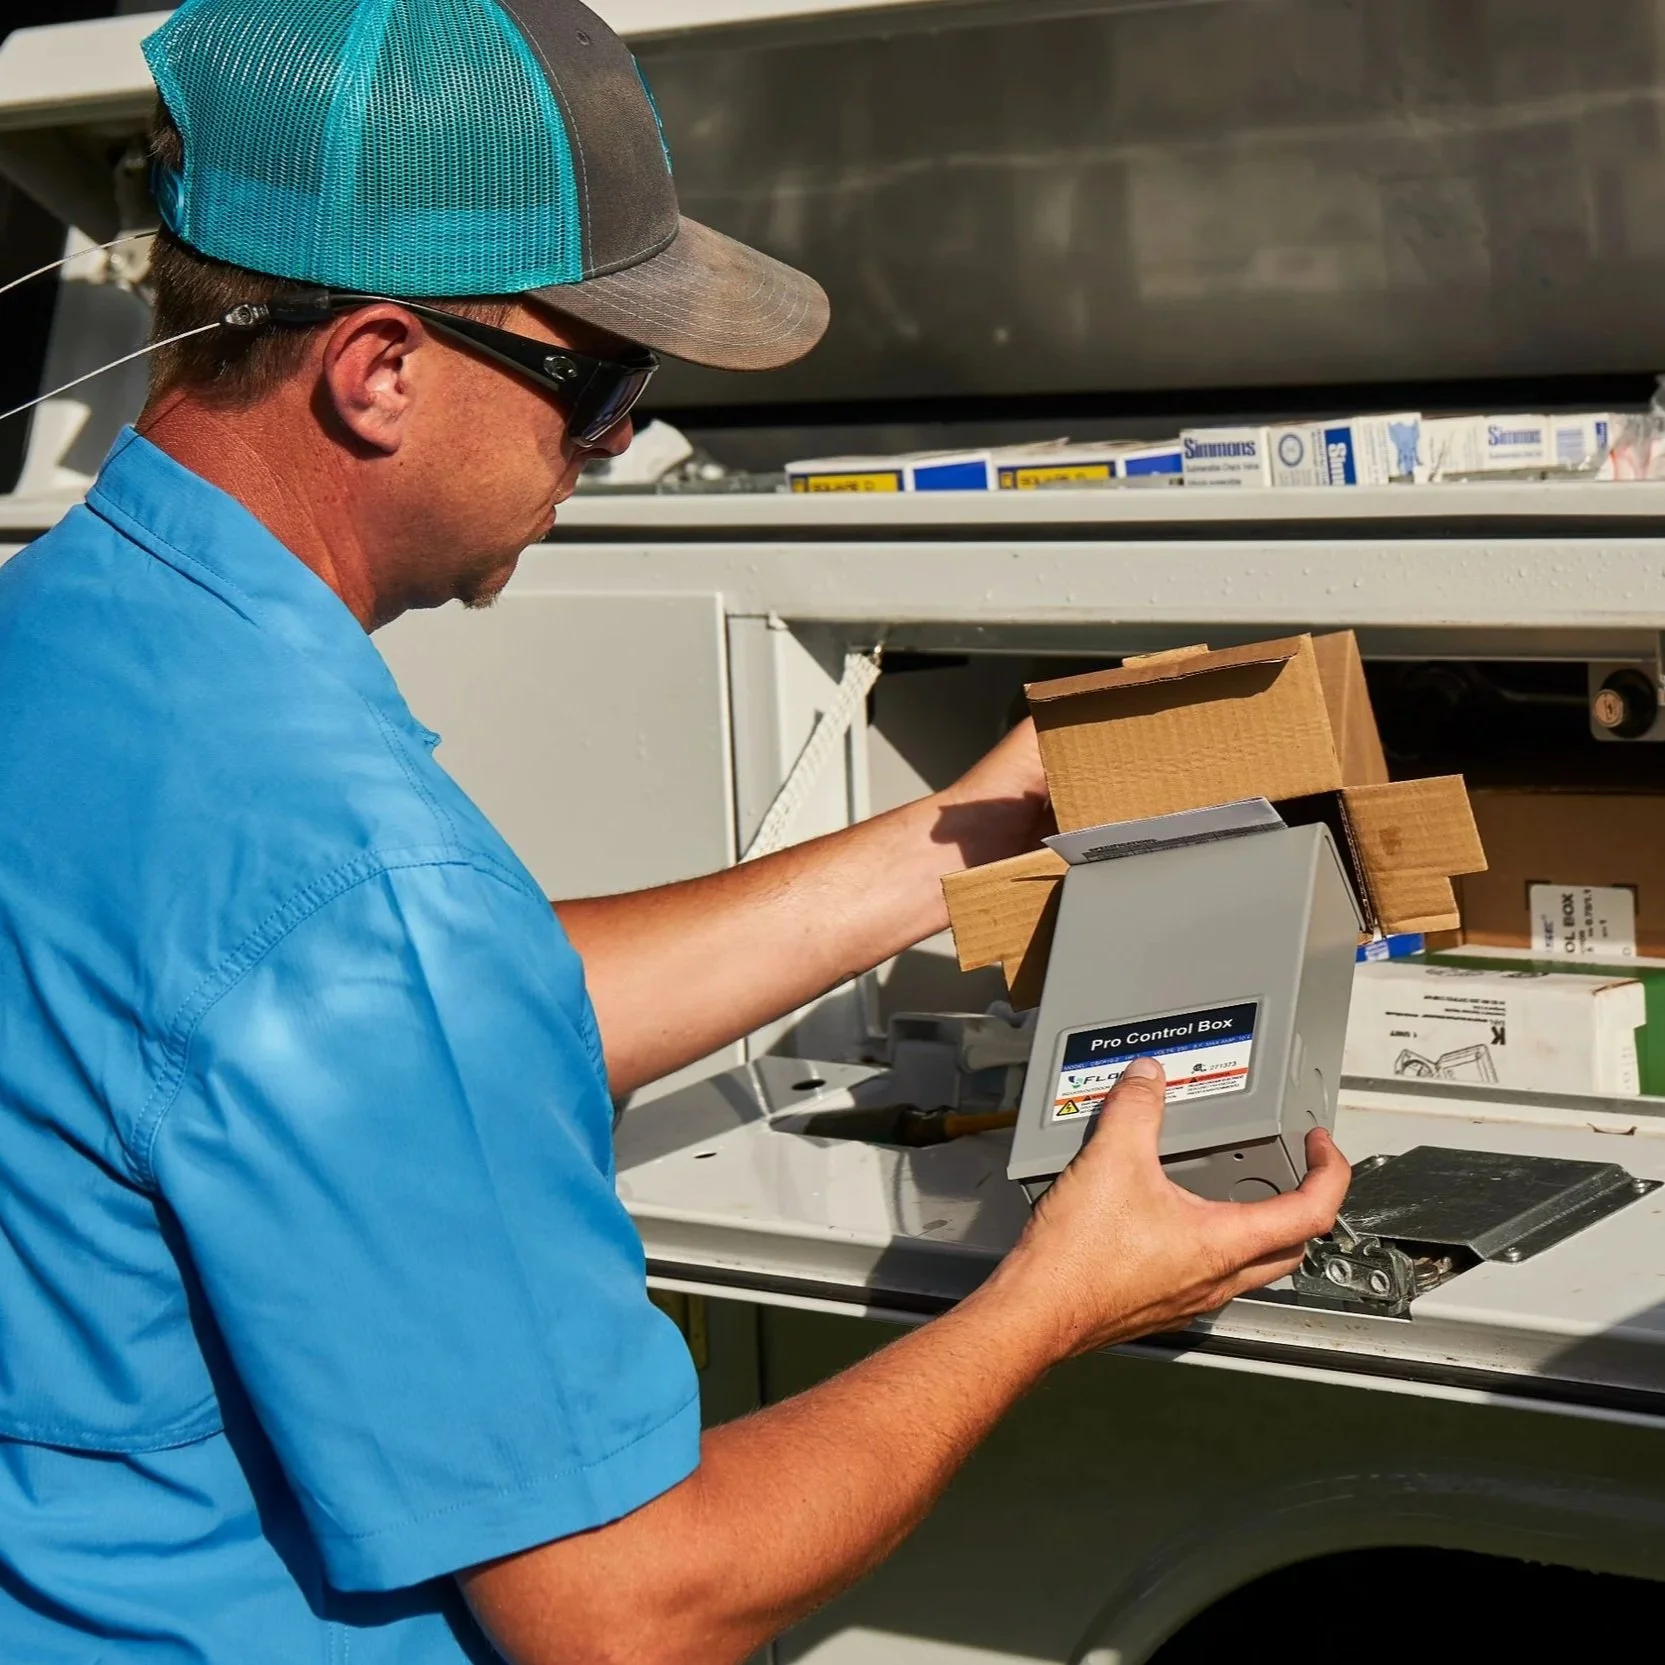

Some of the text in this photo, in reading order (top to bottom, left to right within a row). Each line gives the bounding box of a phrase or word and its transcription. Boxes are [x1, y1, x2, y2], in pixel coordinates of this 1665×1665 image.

[1184, 437, 1256, 459] Simmons
[1562, 893, 1575, 927] BOX
[1090, 1018, 1233, 1052] Pro Control Box
[1490, 1026, 1506, 1045] K
